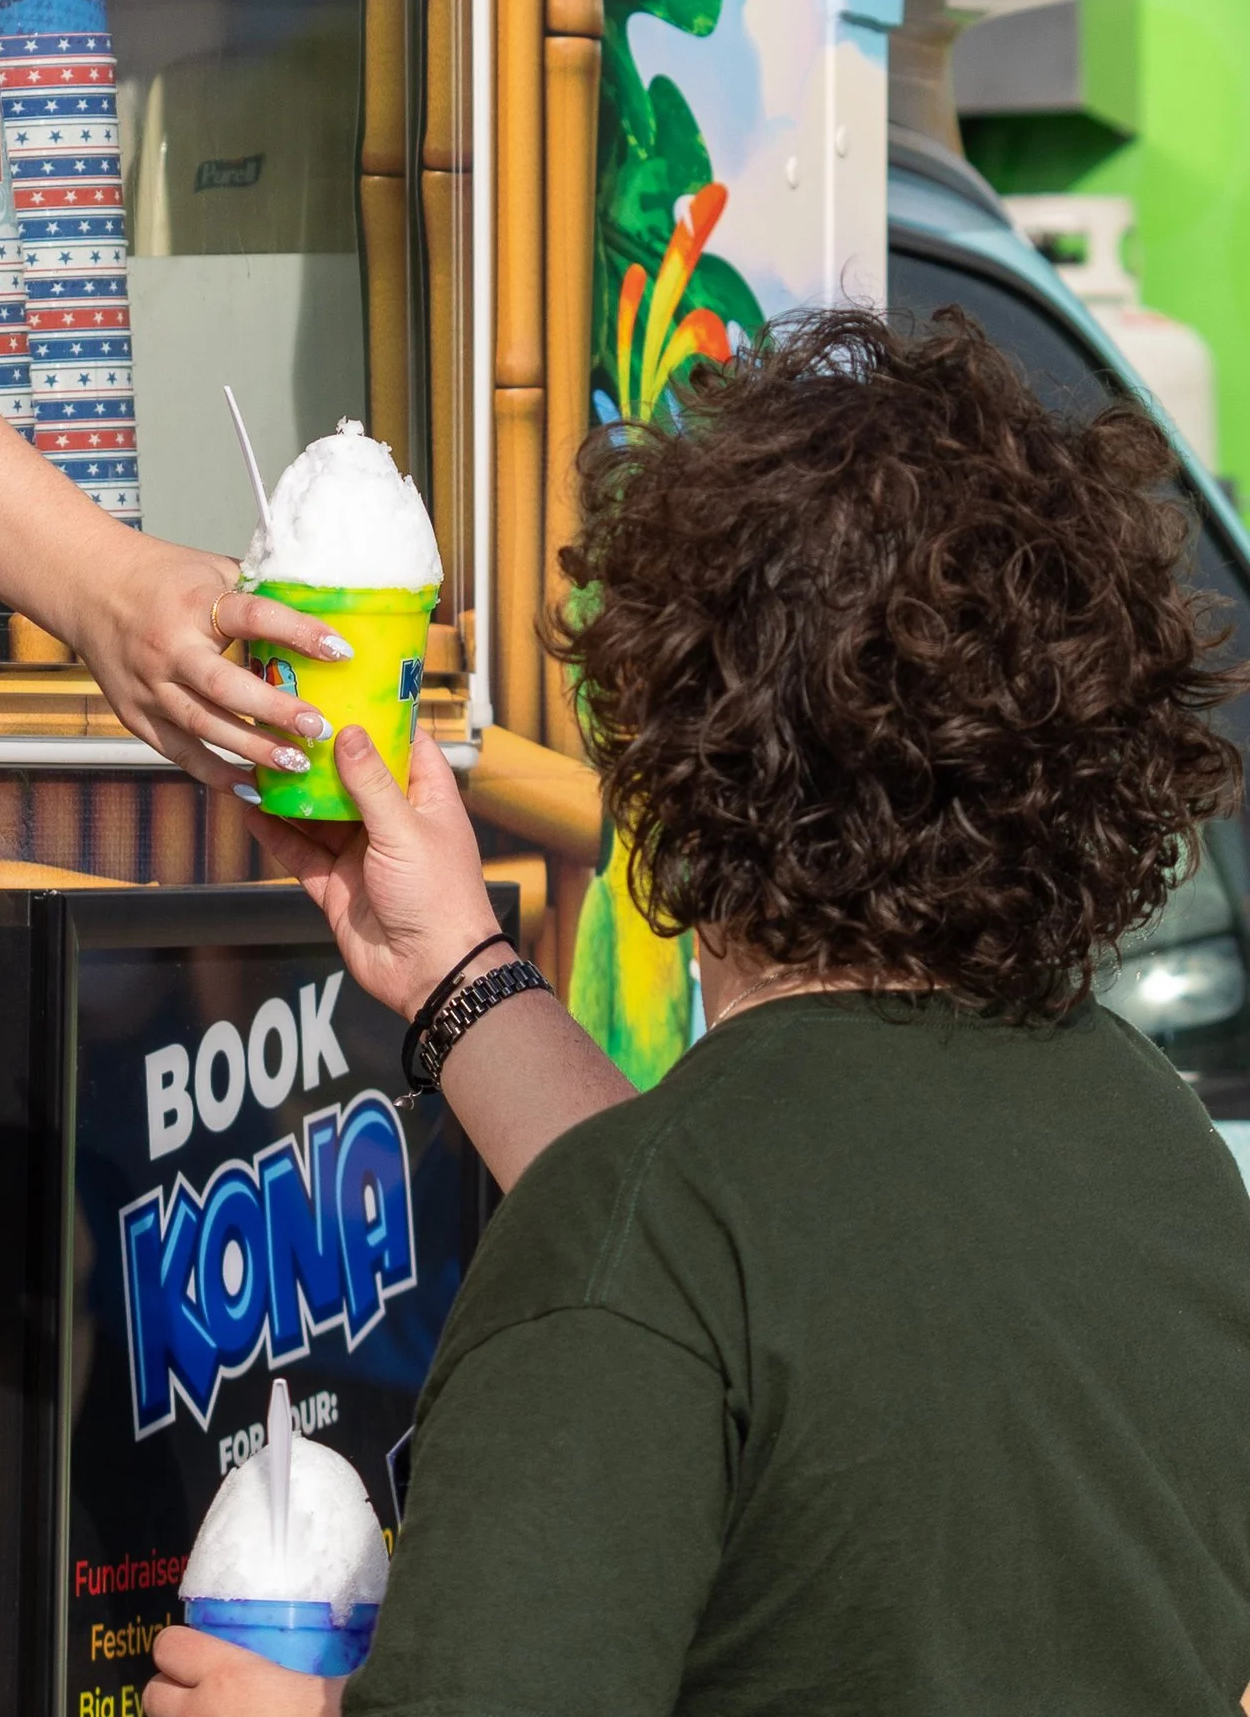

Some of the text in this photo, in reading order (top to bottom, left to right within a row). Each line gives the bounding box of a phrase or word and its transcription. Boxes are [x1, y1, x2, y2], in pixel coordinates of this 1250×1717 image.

[144, 970, 350, 1161] BOOK
[118, 1088, 417, 1442] KONA
[219, 1390, 339, 1475] FOR OUR:
